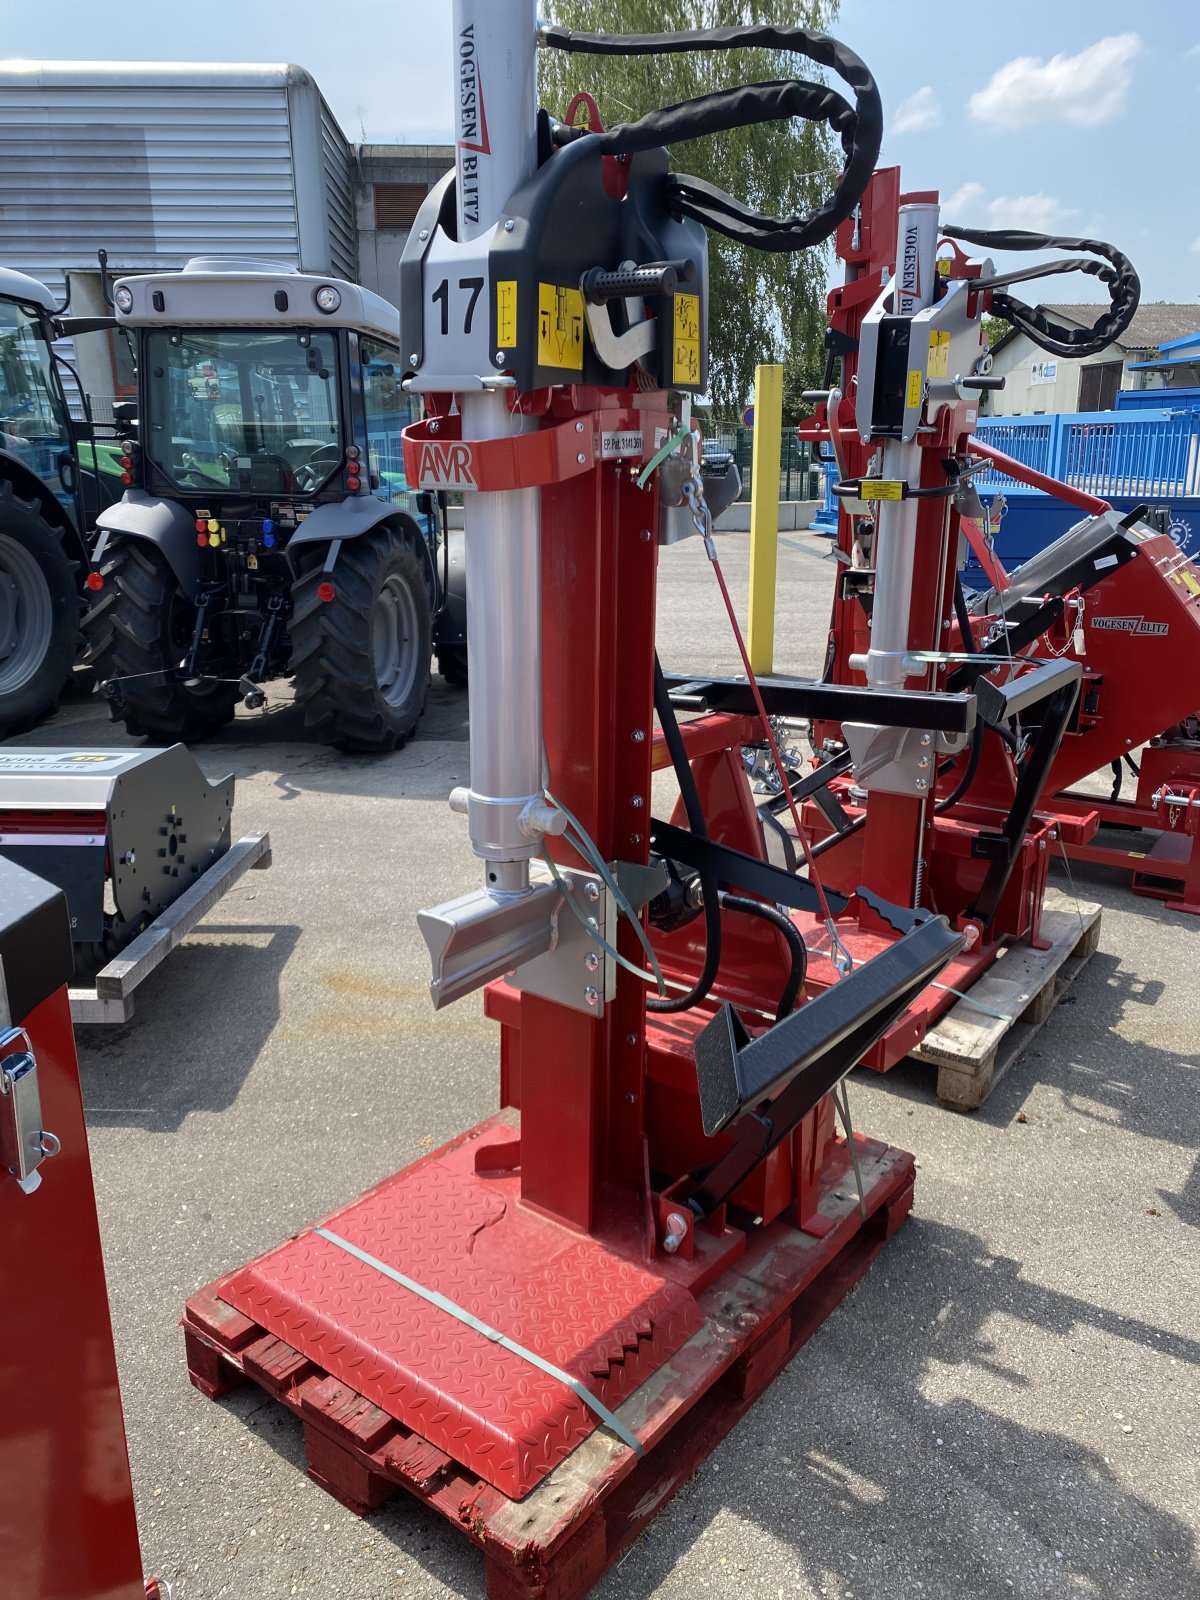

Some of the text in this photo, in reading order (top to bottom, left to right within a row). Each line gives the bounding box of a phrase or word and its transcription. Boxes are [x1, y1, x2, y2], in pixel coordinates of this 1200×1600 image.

[459, 24, 479, 226] VOGESEN BLITZ
[902, 227, 917, 289] VOGESEN
[431, 276, 484, 335] 17
[420, 445, 473, 484] AMR
[1093, 618, 1168, 634] VOGESEN BLITZ
